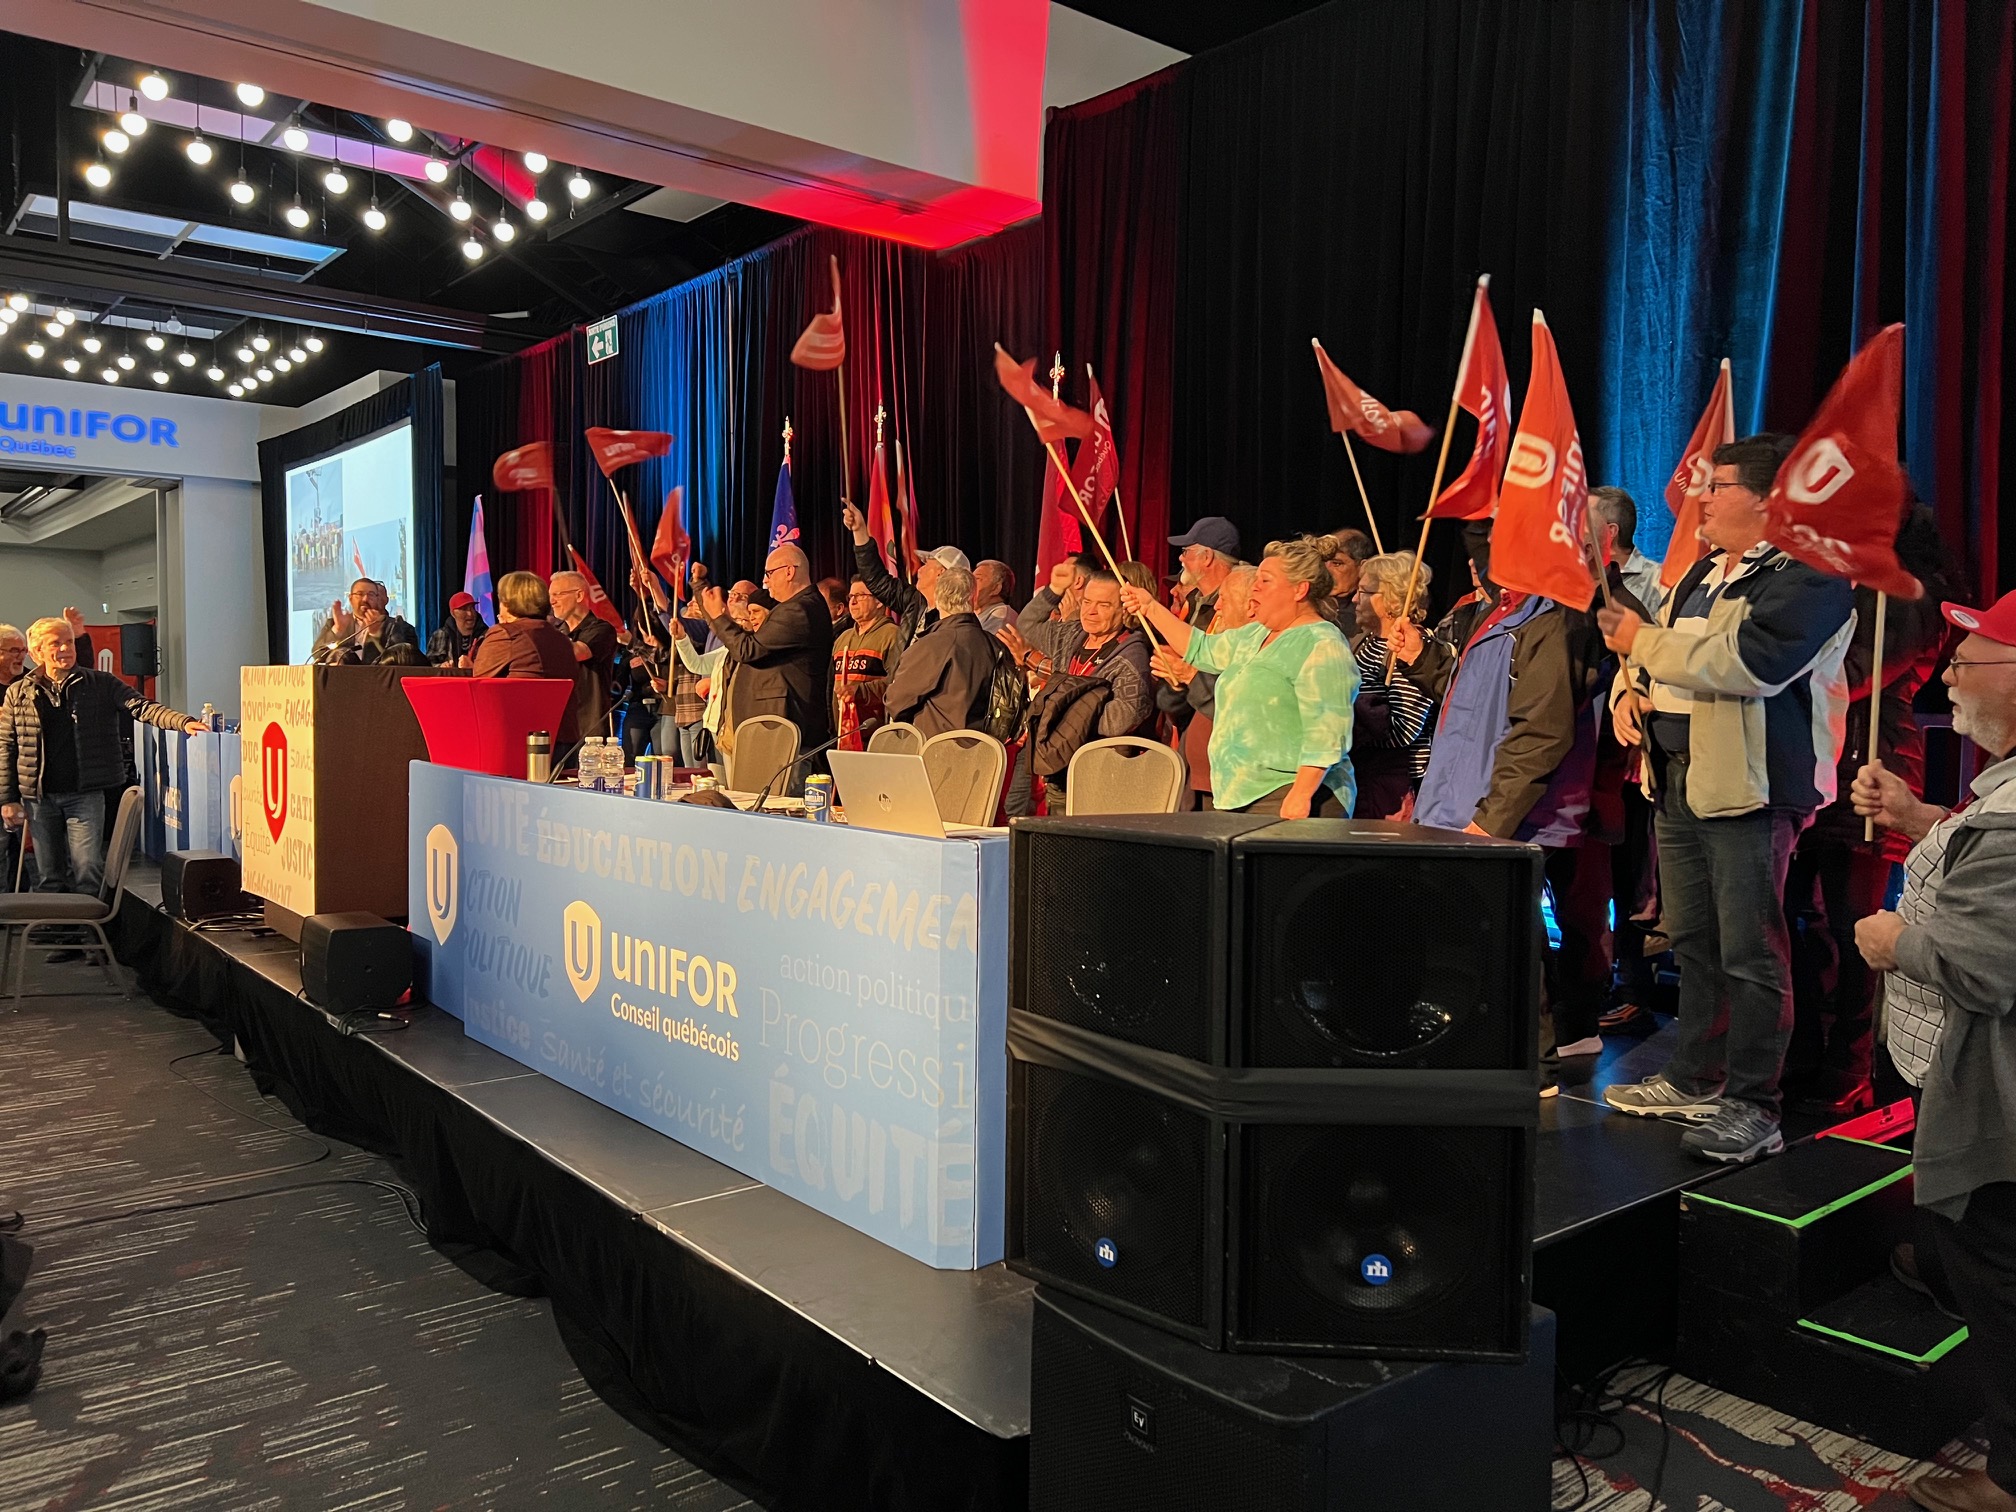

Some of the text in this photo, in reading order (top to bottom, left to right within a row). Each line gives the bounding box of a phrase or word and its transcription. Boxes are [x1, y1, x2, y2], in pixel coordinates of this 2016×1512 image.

[0, 435, 77, 459] Québec
[537, 806, 730, 905] ÉDUCATION
[611, 992, 740, 1063] Conseil québécois
[780, 953, 976, 1029] action politiqu
[611, 1064, 631, 1097] et
[639, 1072, 745, 1153] sécurité
